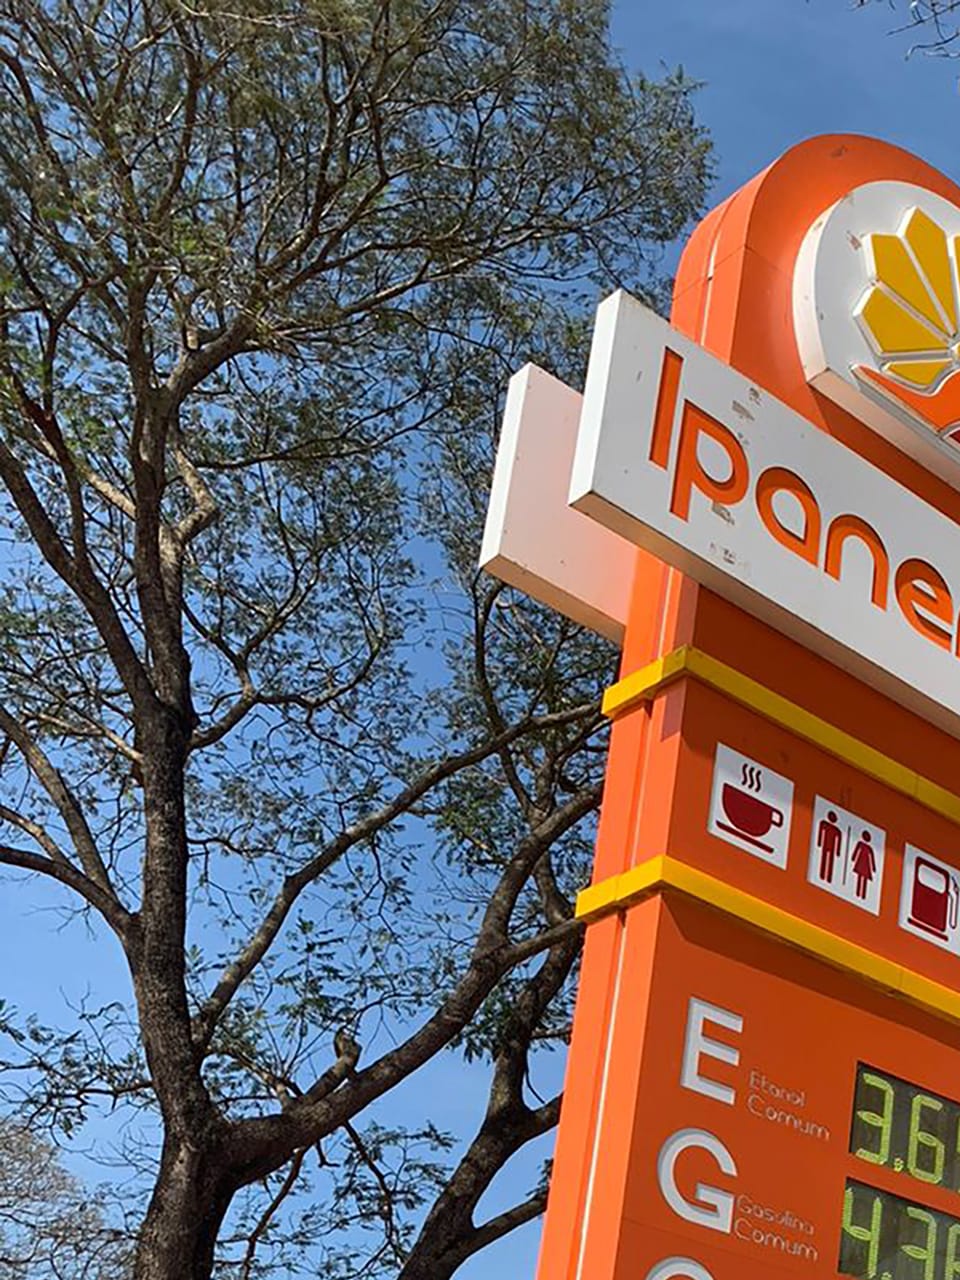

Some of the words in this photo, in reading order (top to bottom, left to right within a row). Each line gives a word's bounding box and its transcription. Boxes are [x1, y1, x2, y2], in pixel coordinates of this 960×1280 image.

[680, 997, 744, 1105] E
[749, 1070, 806, 1108] Etanol
[747, 1094, 831, 1141] Comum
[657, 1128, 738, 1234] G
[736, 1194, 815, 1236] Gasolina
[734, 1217, 819, 1262] Comum
